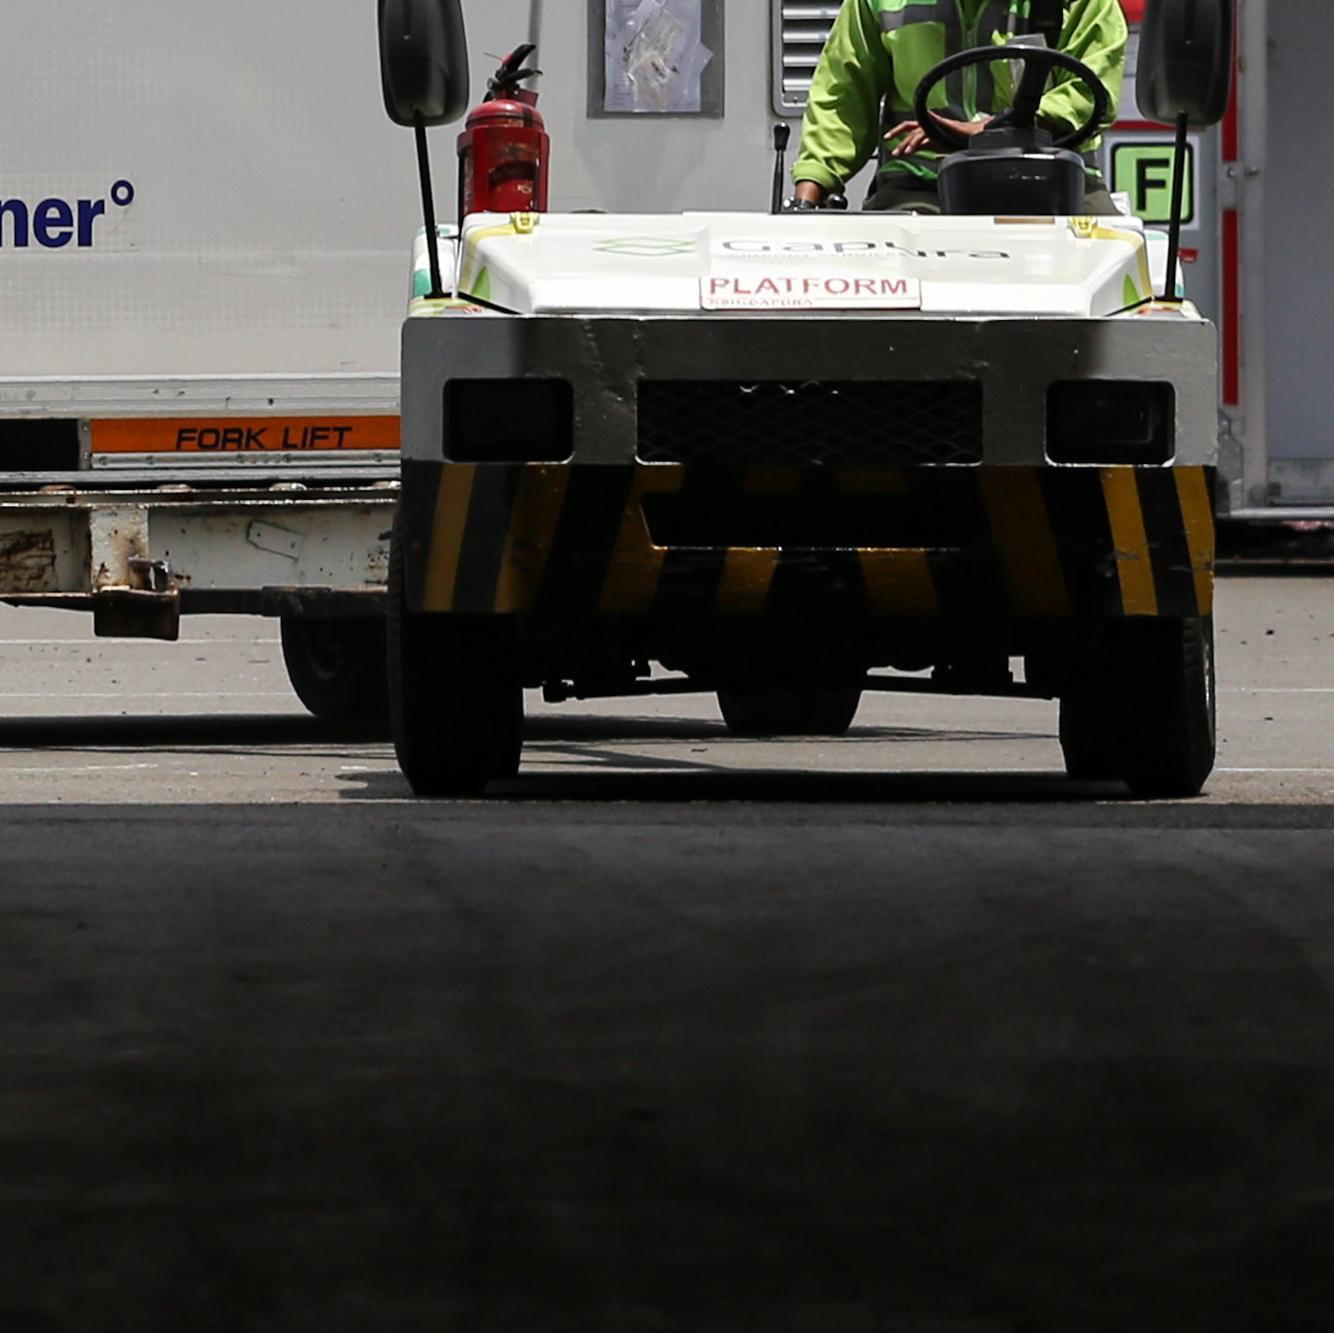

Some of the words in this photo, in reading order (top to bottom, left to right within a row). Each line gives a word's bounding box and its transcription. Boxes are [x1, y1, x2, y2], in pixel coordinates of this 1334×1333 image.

[1136, 158, 1170, 212] F
[722, 240, 1011, 259] Gapura
[709, 277, 908, 296] PLATFORM
[175, 427, 267, 450] FORK
[282, 426, 353, 449] LIFT
